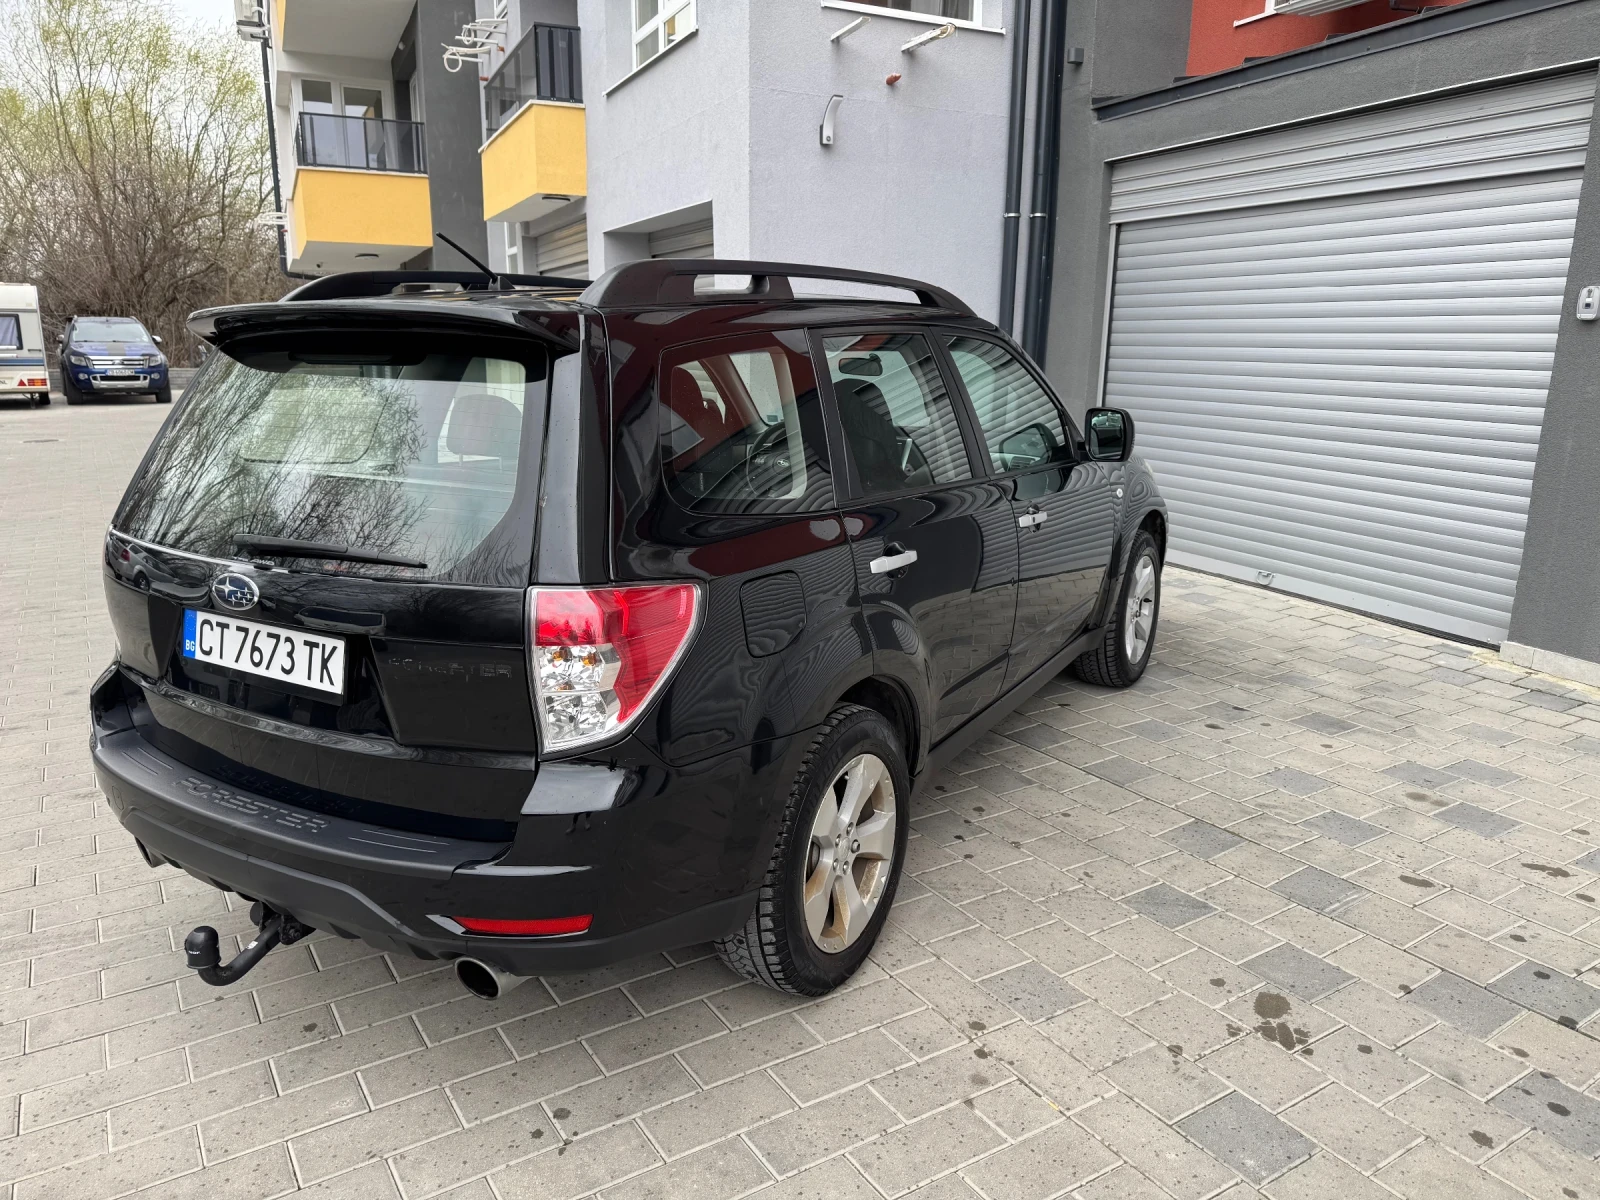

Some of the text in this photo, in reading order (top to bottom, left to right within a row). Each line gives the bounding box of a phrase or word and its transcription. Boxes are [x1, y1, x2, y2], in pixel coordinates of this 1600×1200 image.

[185, 639, 196, 652] BG
[199, 618, 338, 687] CT 7673 TK
[172, 777, 331, 833] FORESTER
